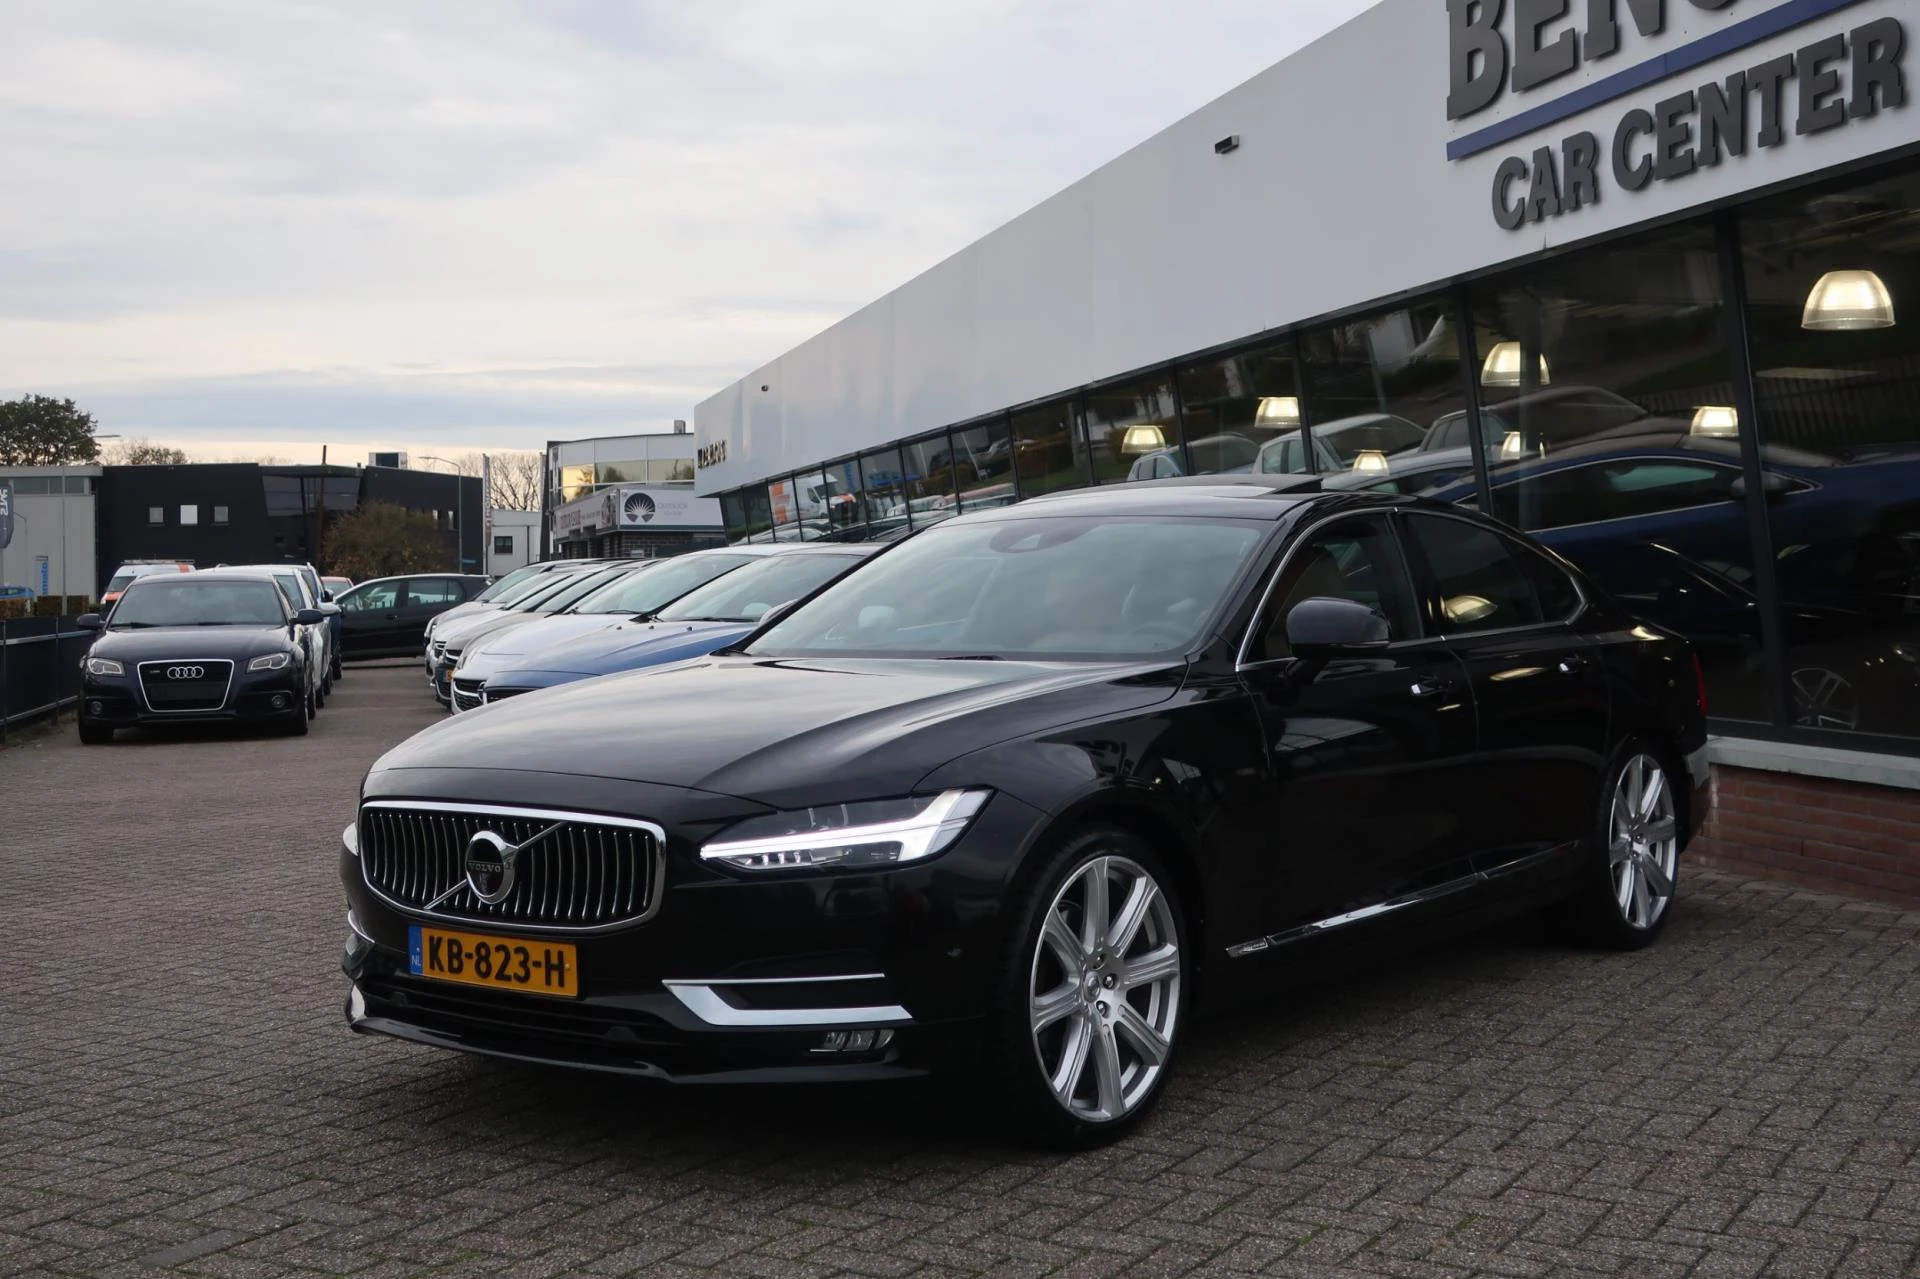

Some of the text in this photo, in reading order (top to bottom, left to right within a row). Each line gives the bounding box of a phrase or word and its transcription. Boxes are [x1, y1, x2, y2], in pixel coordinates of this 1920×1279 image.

[1446, 0, 1736, 121] BE
[1492, 17, 1904, 229] CAR CENTER
[467, 862, 501, 872] VOLVO
[411, 955, 422, 967] NL
[428, 935, 565, 988] KB-823-H
